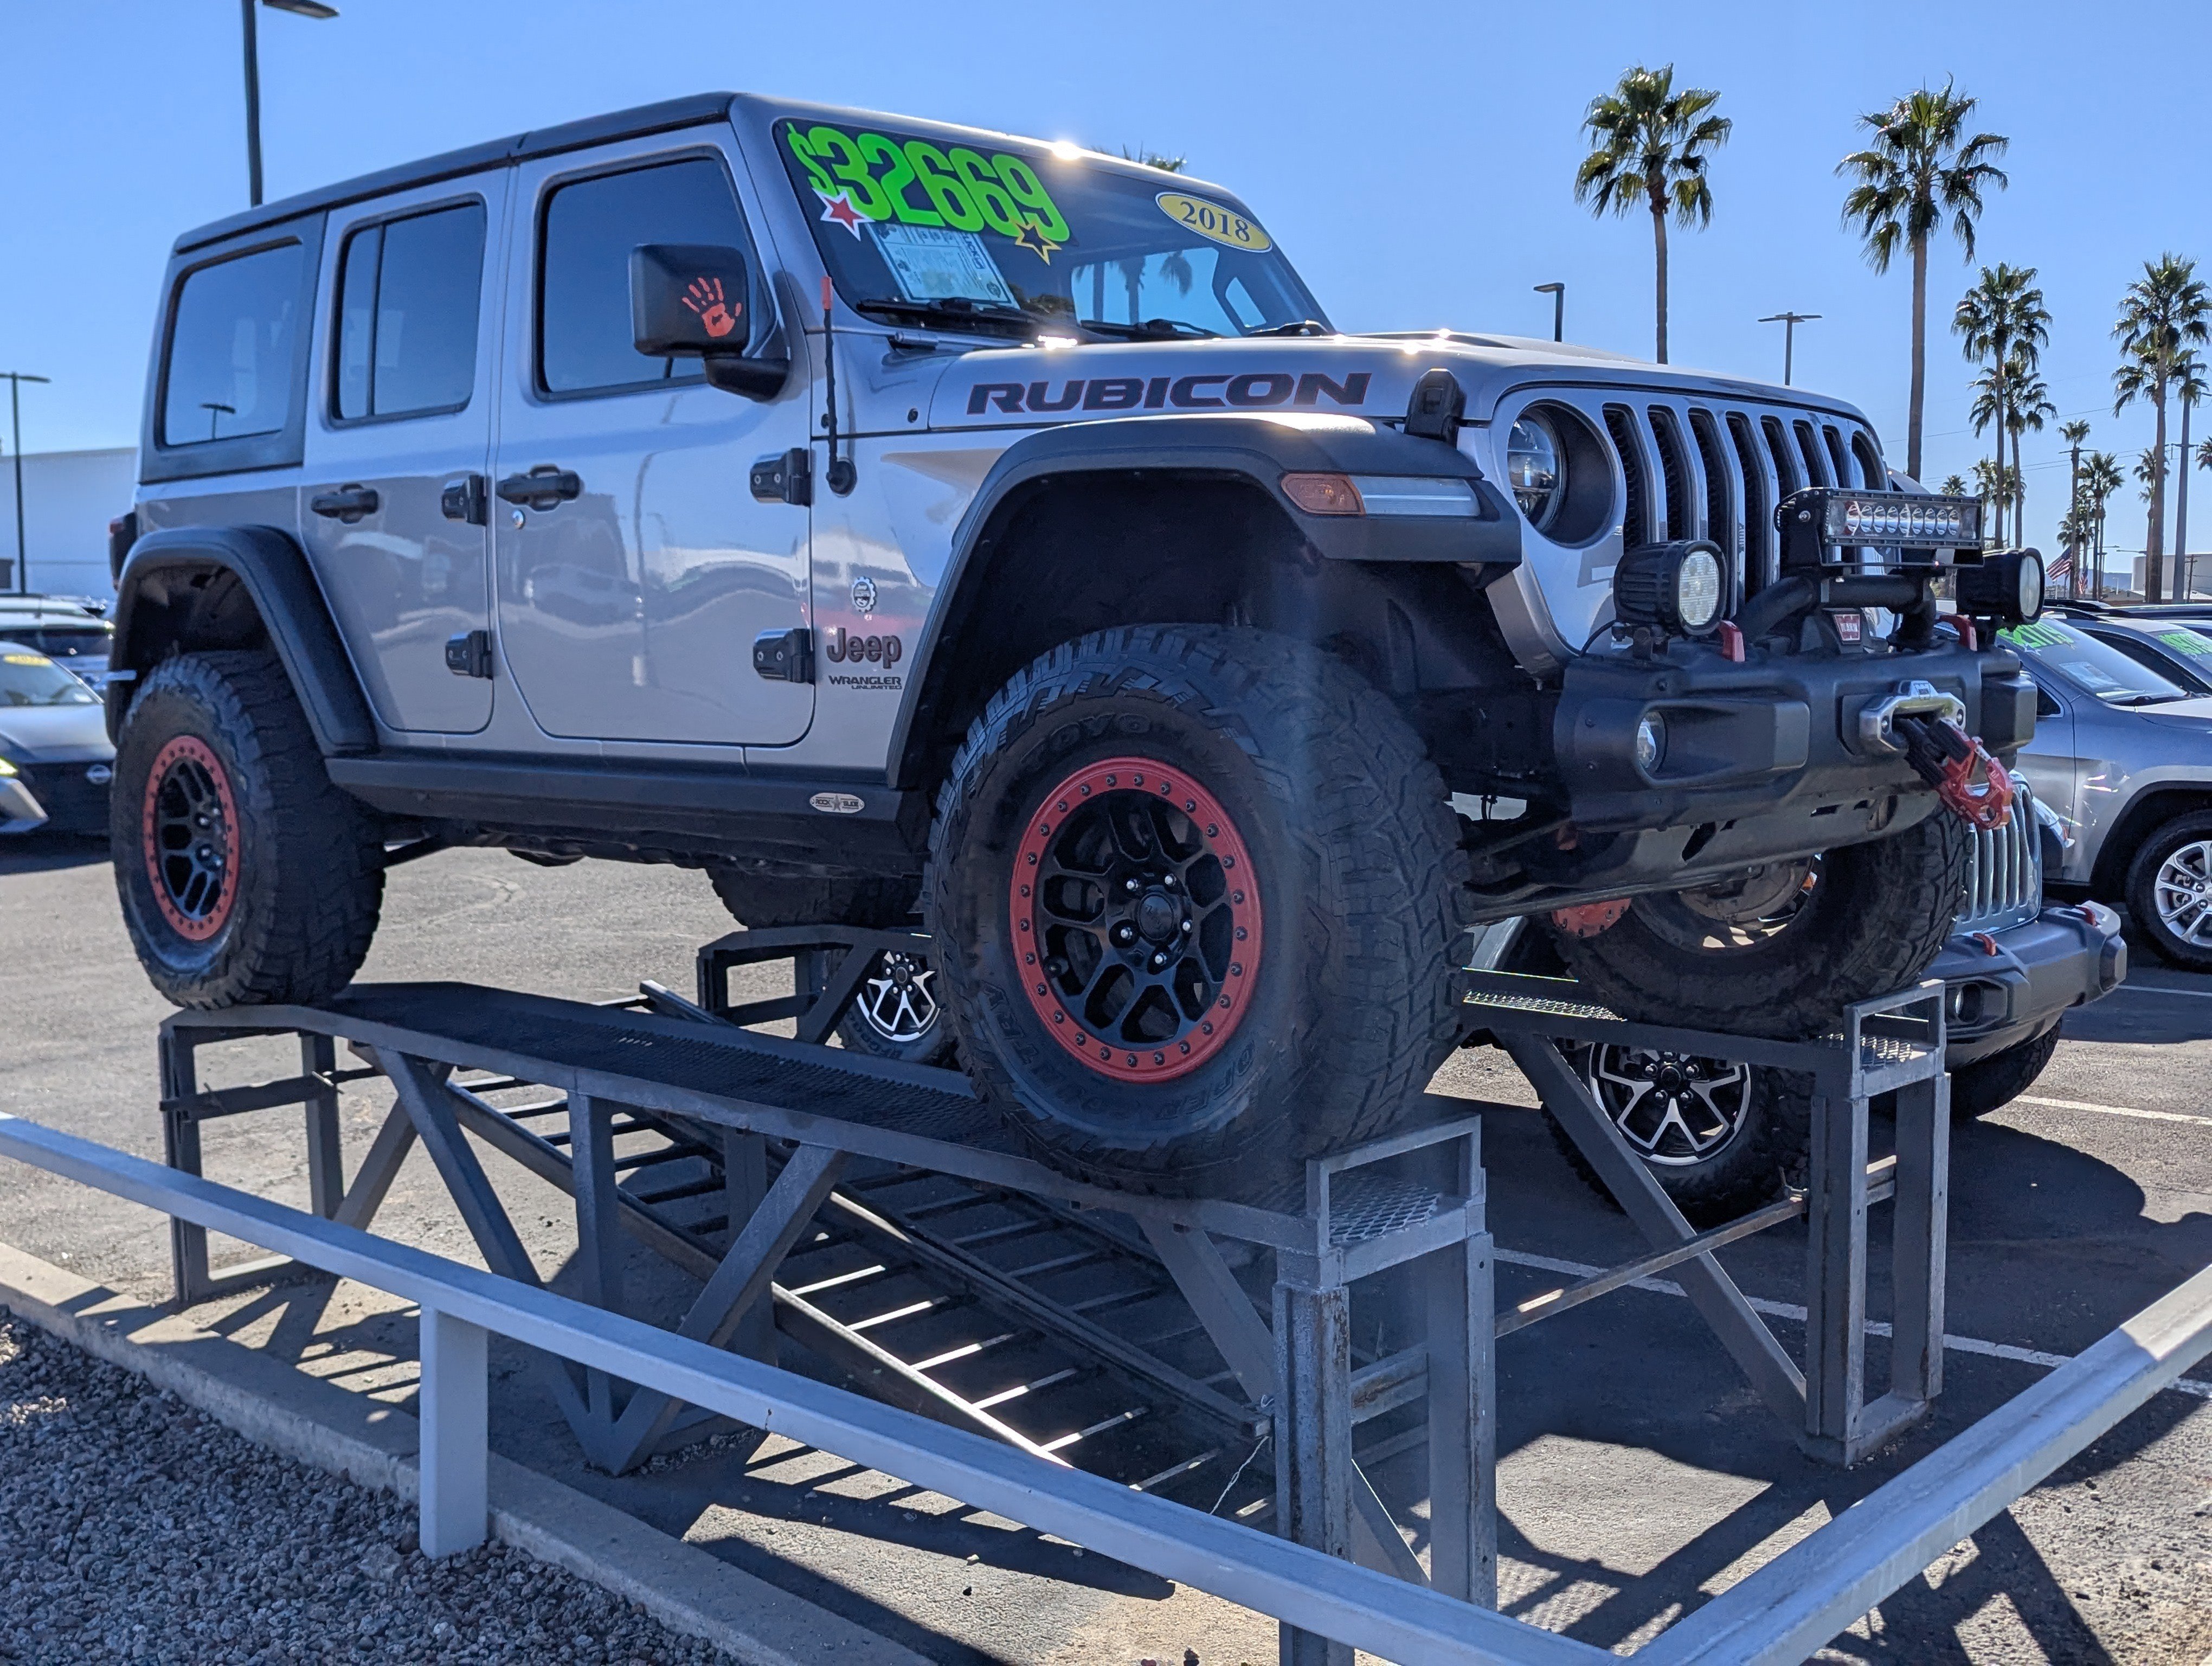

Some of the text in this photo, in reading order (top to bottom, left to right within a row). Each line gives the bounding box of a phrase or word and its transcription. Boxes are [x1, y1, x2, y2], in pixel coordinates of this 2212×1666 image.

[787, 122, 1070, 242] $32669
[1180, 201, 1250, 242] 2018
[967, 373, 1372, 414] RUBICON
[826, 627, 902, 669] Jeep
[828, 675, 901, 685] WRANGLER
